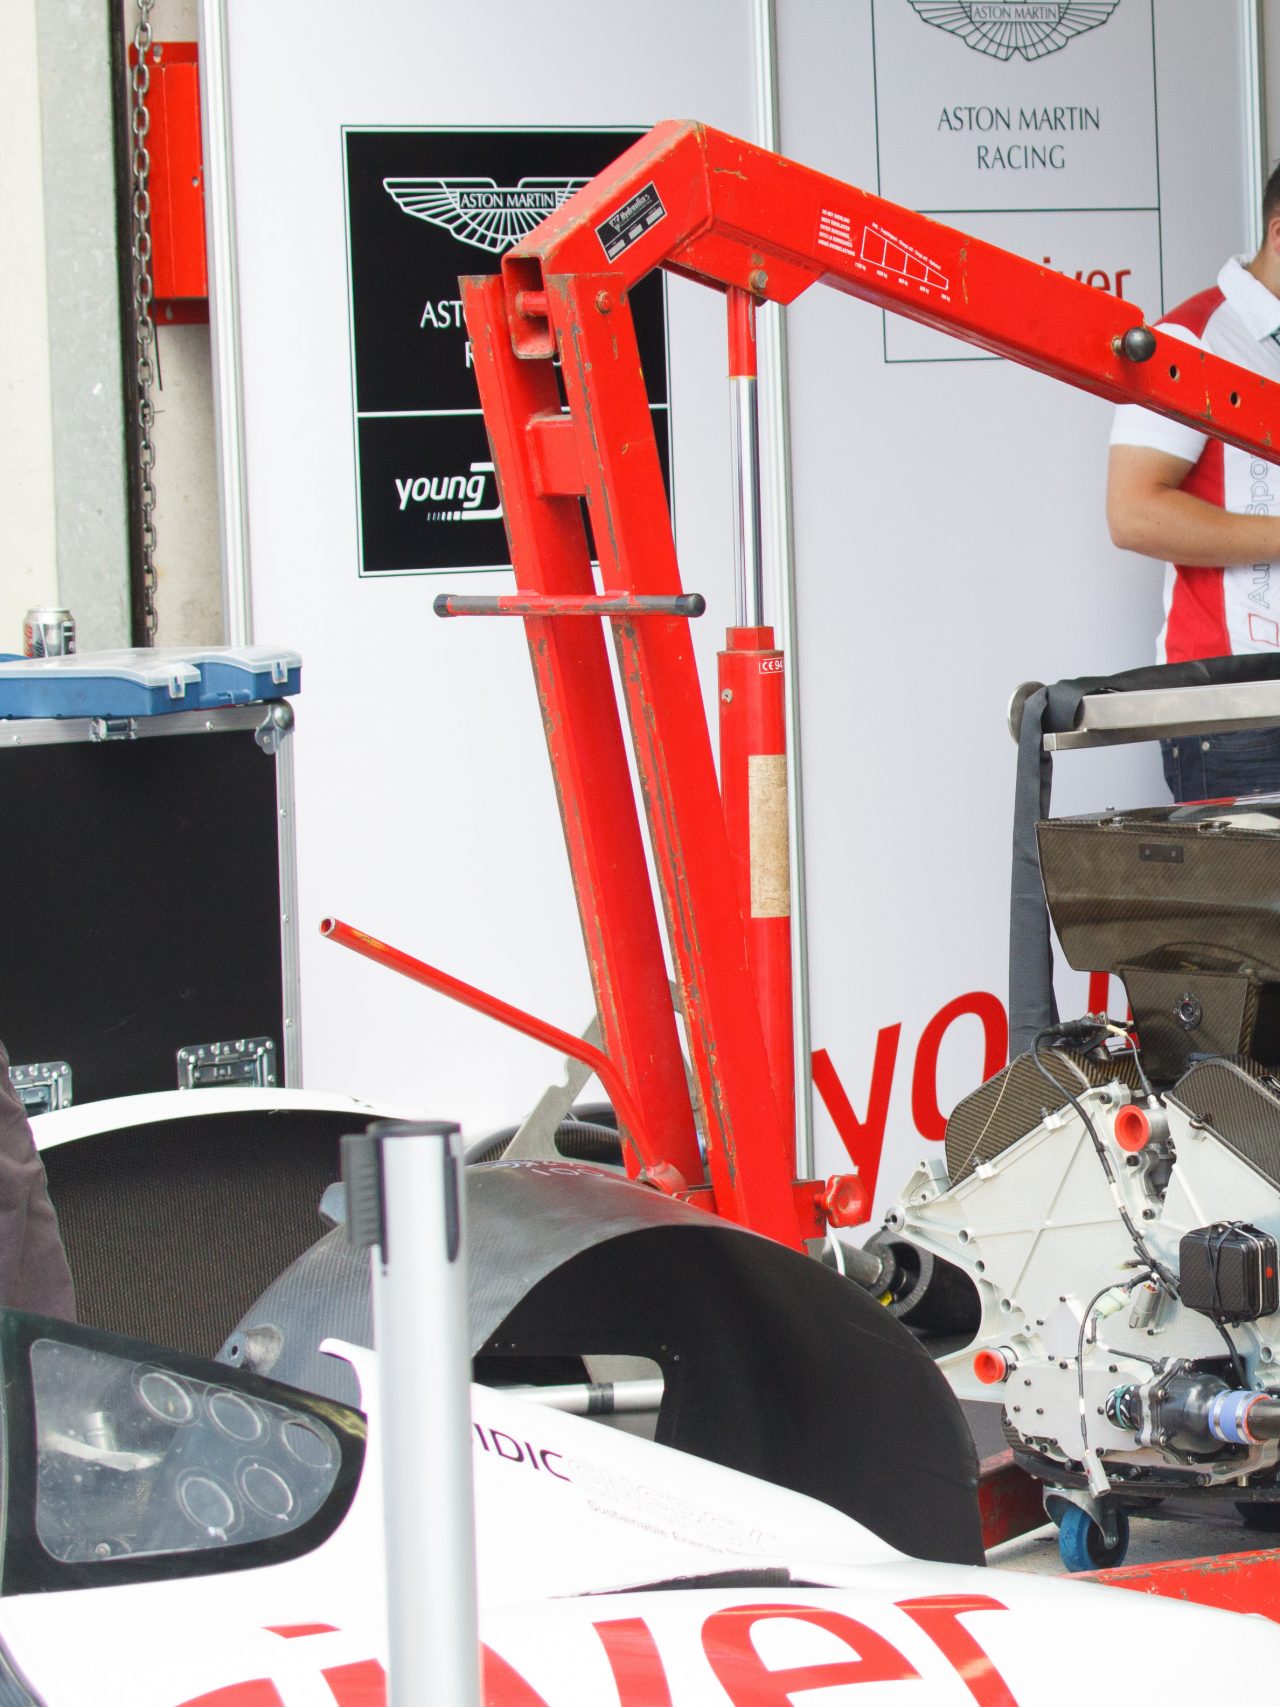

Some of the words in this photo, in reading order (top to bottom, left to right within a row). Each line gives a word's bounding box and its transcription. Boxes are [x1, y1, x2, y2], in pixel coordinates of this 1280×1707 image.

[973, 6, 1011, 19] ASTON
[1014, 6, 1057, 20] MARTIN
[937, 106, 1011, 131] ASTON
[1018, 106, 1100, 131] MARTIN
[977, 144, 1065, 169] RACING
[460, 192, 504, 208] ASTON
[506, 192, 555, 208] MARTIN
[420, 300, 466, 328] AST
